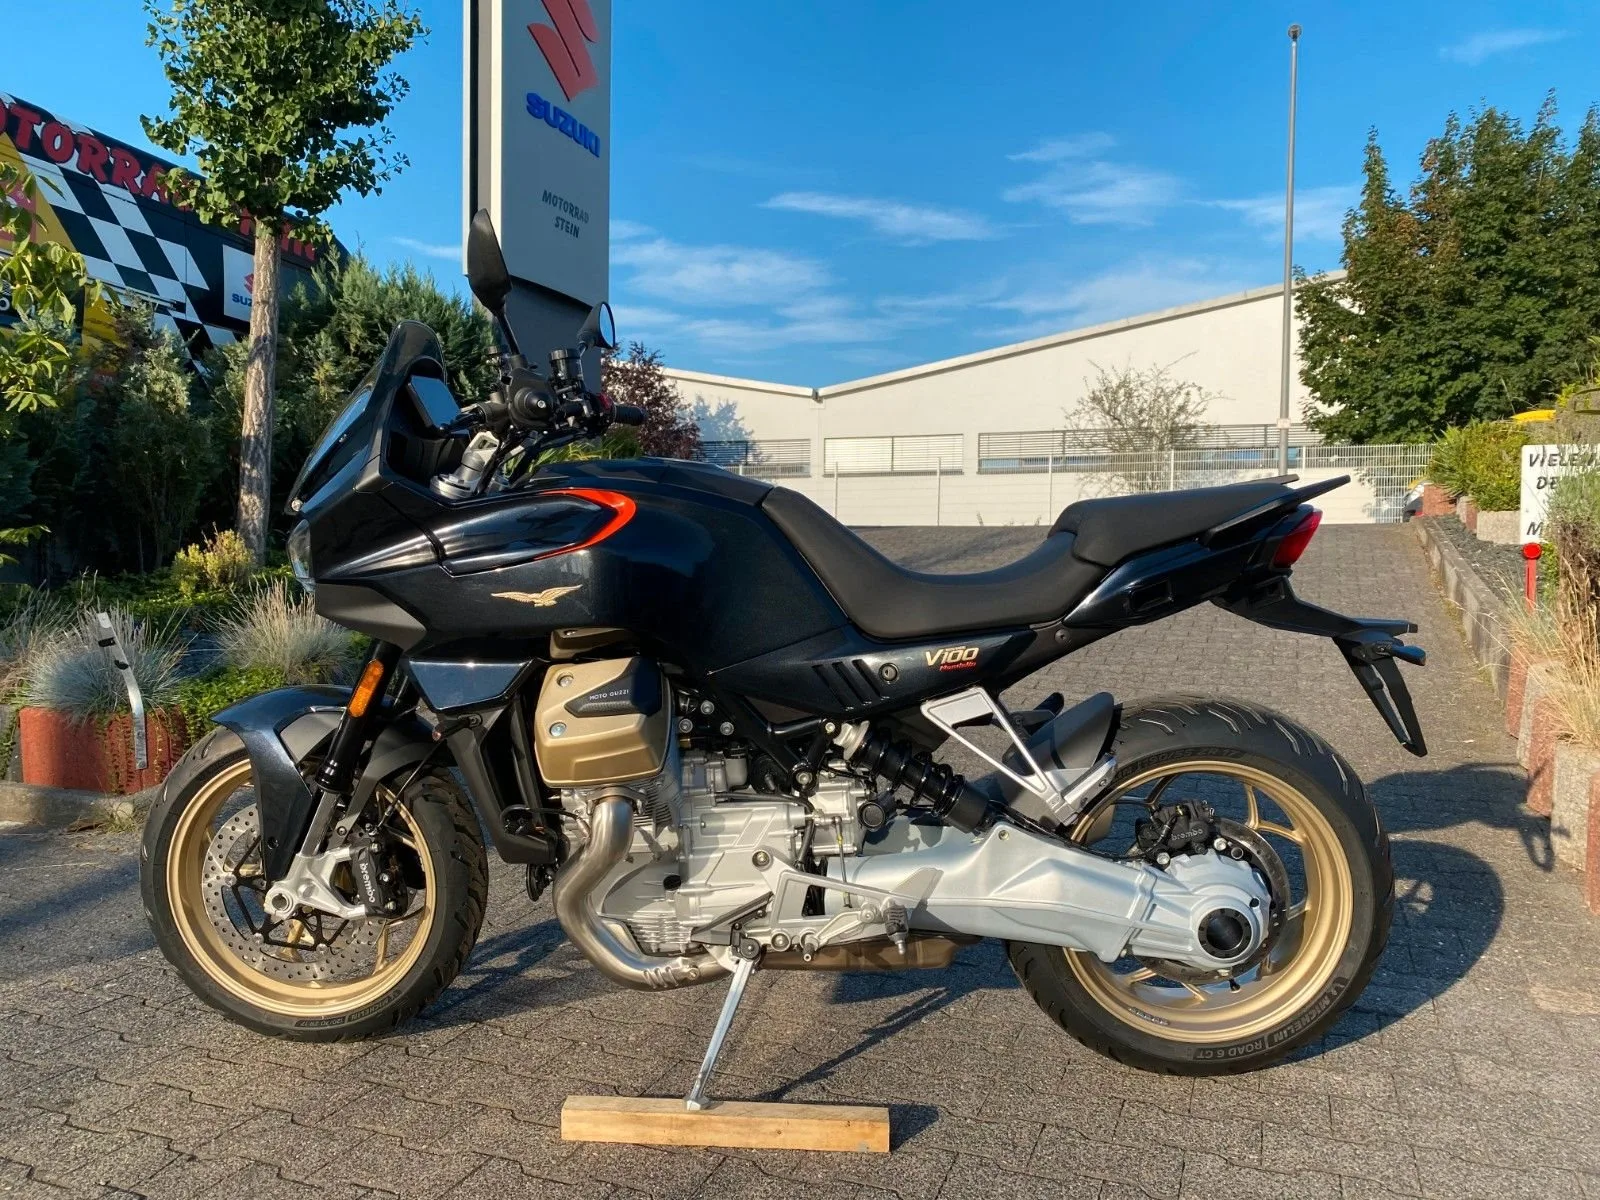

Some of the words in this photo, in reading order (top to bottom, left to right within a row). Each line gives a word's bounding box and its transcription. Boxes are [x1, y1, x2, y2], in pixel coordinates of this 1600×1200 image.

[526, 92, 600, 158] SUZUKI
[0, 102, 194, 212] TORRA
[542, 190, 590, 224] MOTORRAD
[555, 216, 580, 238] STEIN
[925, 645, 980, 666] V100
[589, 692, 608, 701] MOTO
[609, 689, 630, 697] GUZZI
[1171, 827, 1203, 841] brembo
[359, 862, 376, 903] brembo
[1273, 994, 1332, 1043] MICHELIN
[1216, 1049, 1225, 1059] 6
[1228, 1039, 1263, 1056] ROAD
